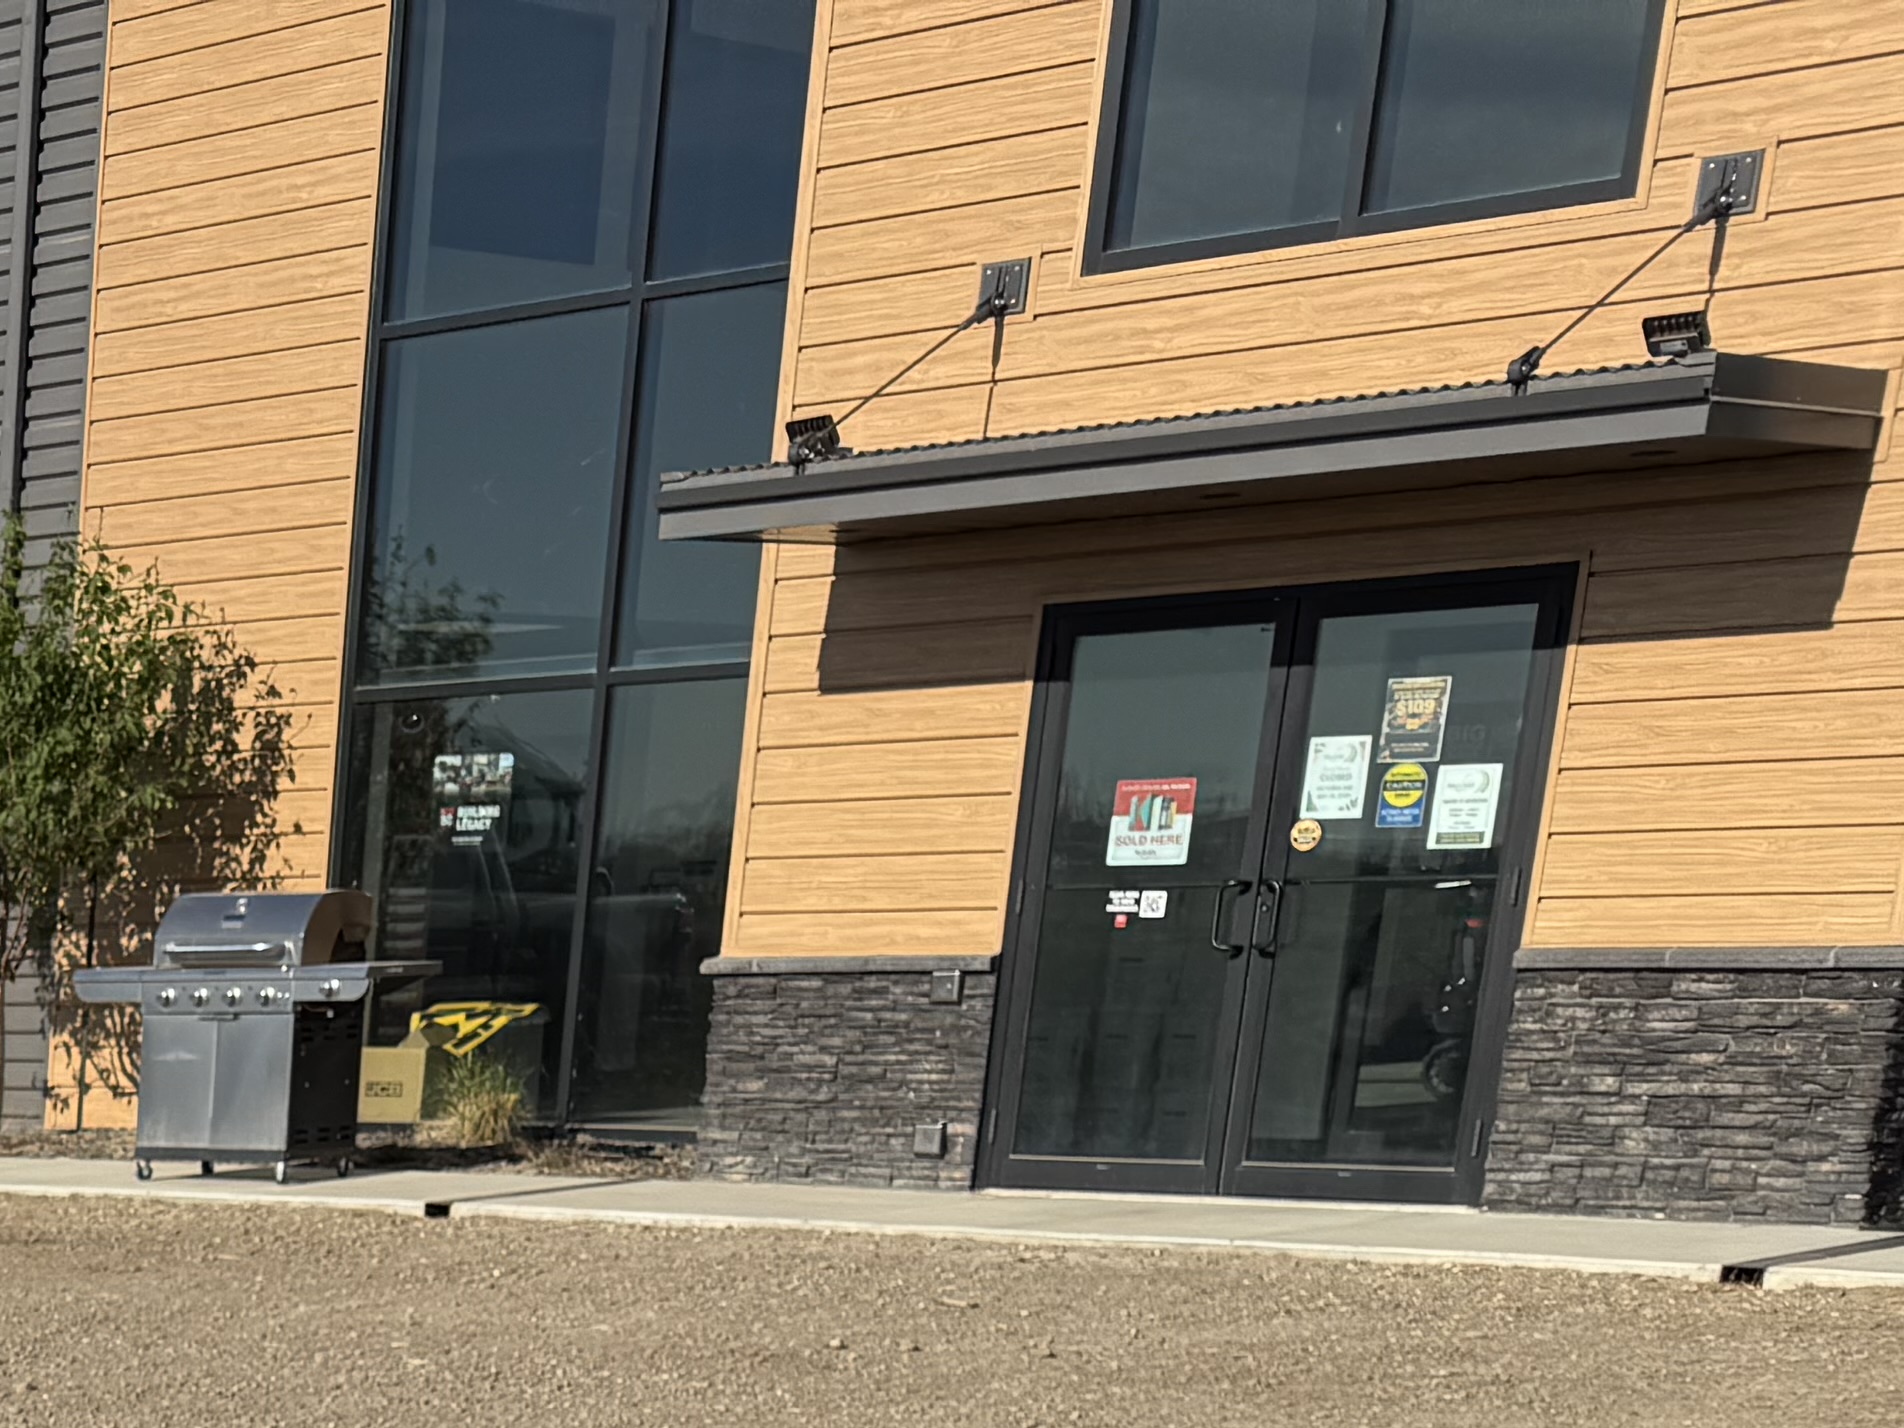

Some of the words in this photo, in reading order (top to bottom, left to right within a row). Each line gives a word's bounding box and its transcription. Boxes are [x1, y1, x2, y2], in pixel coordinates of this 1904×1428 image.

[1395, 699, 1436, 717] $109
[1115, 834, 1148, 847] SOLD
[1150, 834, 1184, 846] HERE
